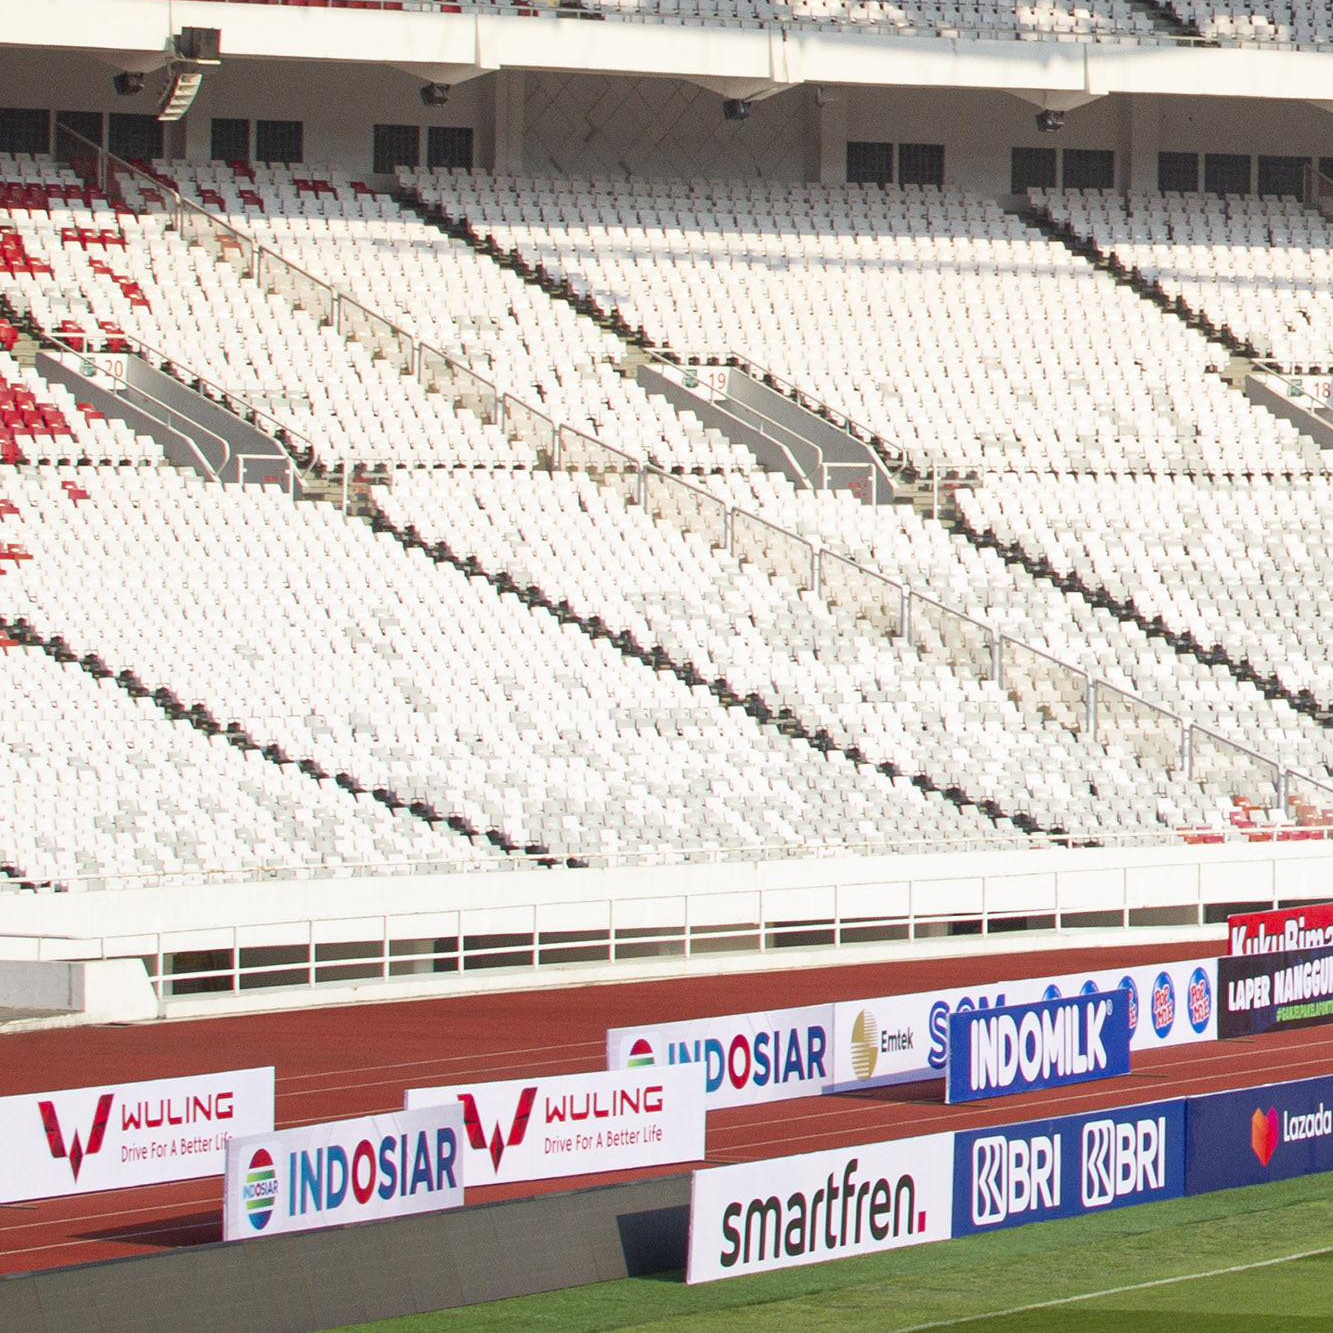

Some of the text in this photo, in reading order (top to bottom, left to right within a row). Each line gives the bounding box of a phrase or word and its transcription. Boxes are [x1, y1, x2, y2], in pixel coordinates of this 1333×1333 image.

[105, 359, 123, 377] 20
[709, 372, 726, 389] 19
[1314, 382, 1330, 398] 18
[1228, 975, 1270, 1011] LAPER
[881, 1027, 913, 1053] Emtek
[121, 1091, 233, 1131] WULING
[545, 1085, 663, 1124] WULING
[1283, 1102, 1332, 1143] Lazada
[121, 1141, 148, 1163] Drive
[151, 1141, 167, 1158] For
[170, 1139, 178, 1155] A
[181, 1136, 212, 1154] Better
[544, 1124, 663, 1155] Drive For A Better Life
[1116, 1116, 1166, 1196] BRI
[289, 1127, 457, 1217] INDOSIAR
[1008, 1133, 1060, 1214] BRI
[242, 1179, 279, 1199] INDOSIAR
